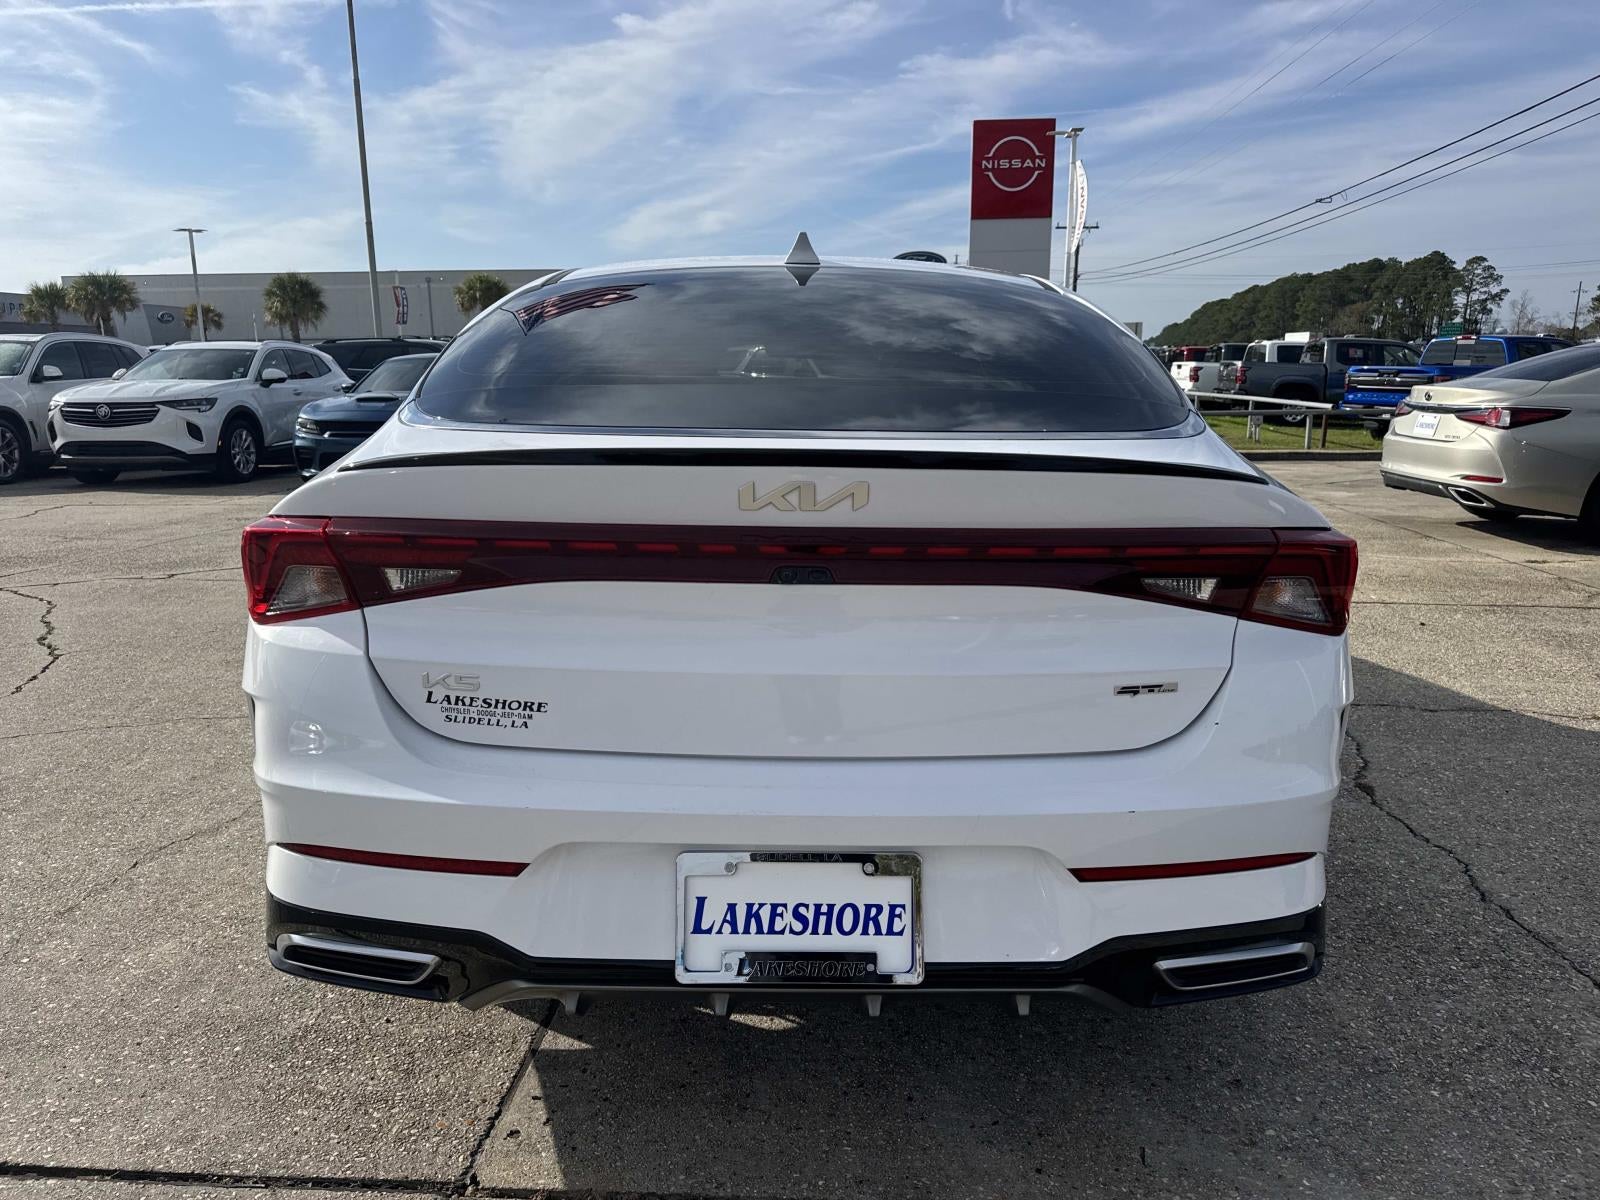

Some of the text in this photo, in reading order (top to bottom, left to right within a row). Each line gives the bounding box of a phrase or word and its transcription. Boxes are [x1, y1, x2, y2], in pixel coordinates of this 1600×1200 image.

[982, 158, 1046, 169] NISSAN
[738, 480, 870, 511] KIA
[422, 671, 480, 691] K5
[425, 690, 548, 713] LAKESHORE
[440, 706, 470, 715] CHRYSLER
[443, 714, 529, 729] SLIDELL, LA
[690, 896, 907, 936] LAKESHORE
[736, 957, 866, 977] LAKESHORE
